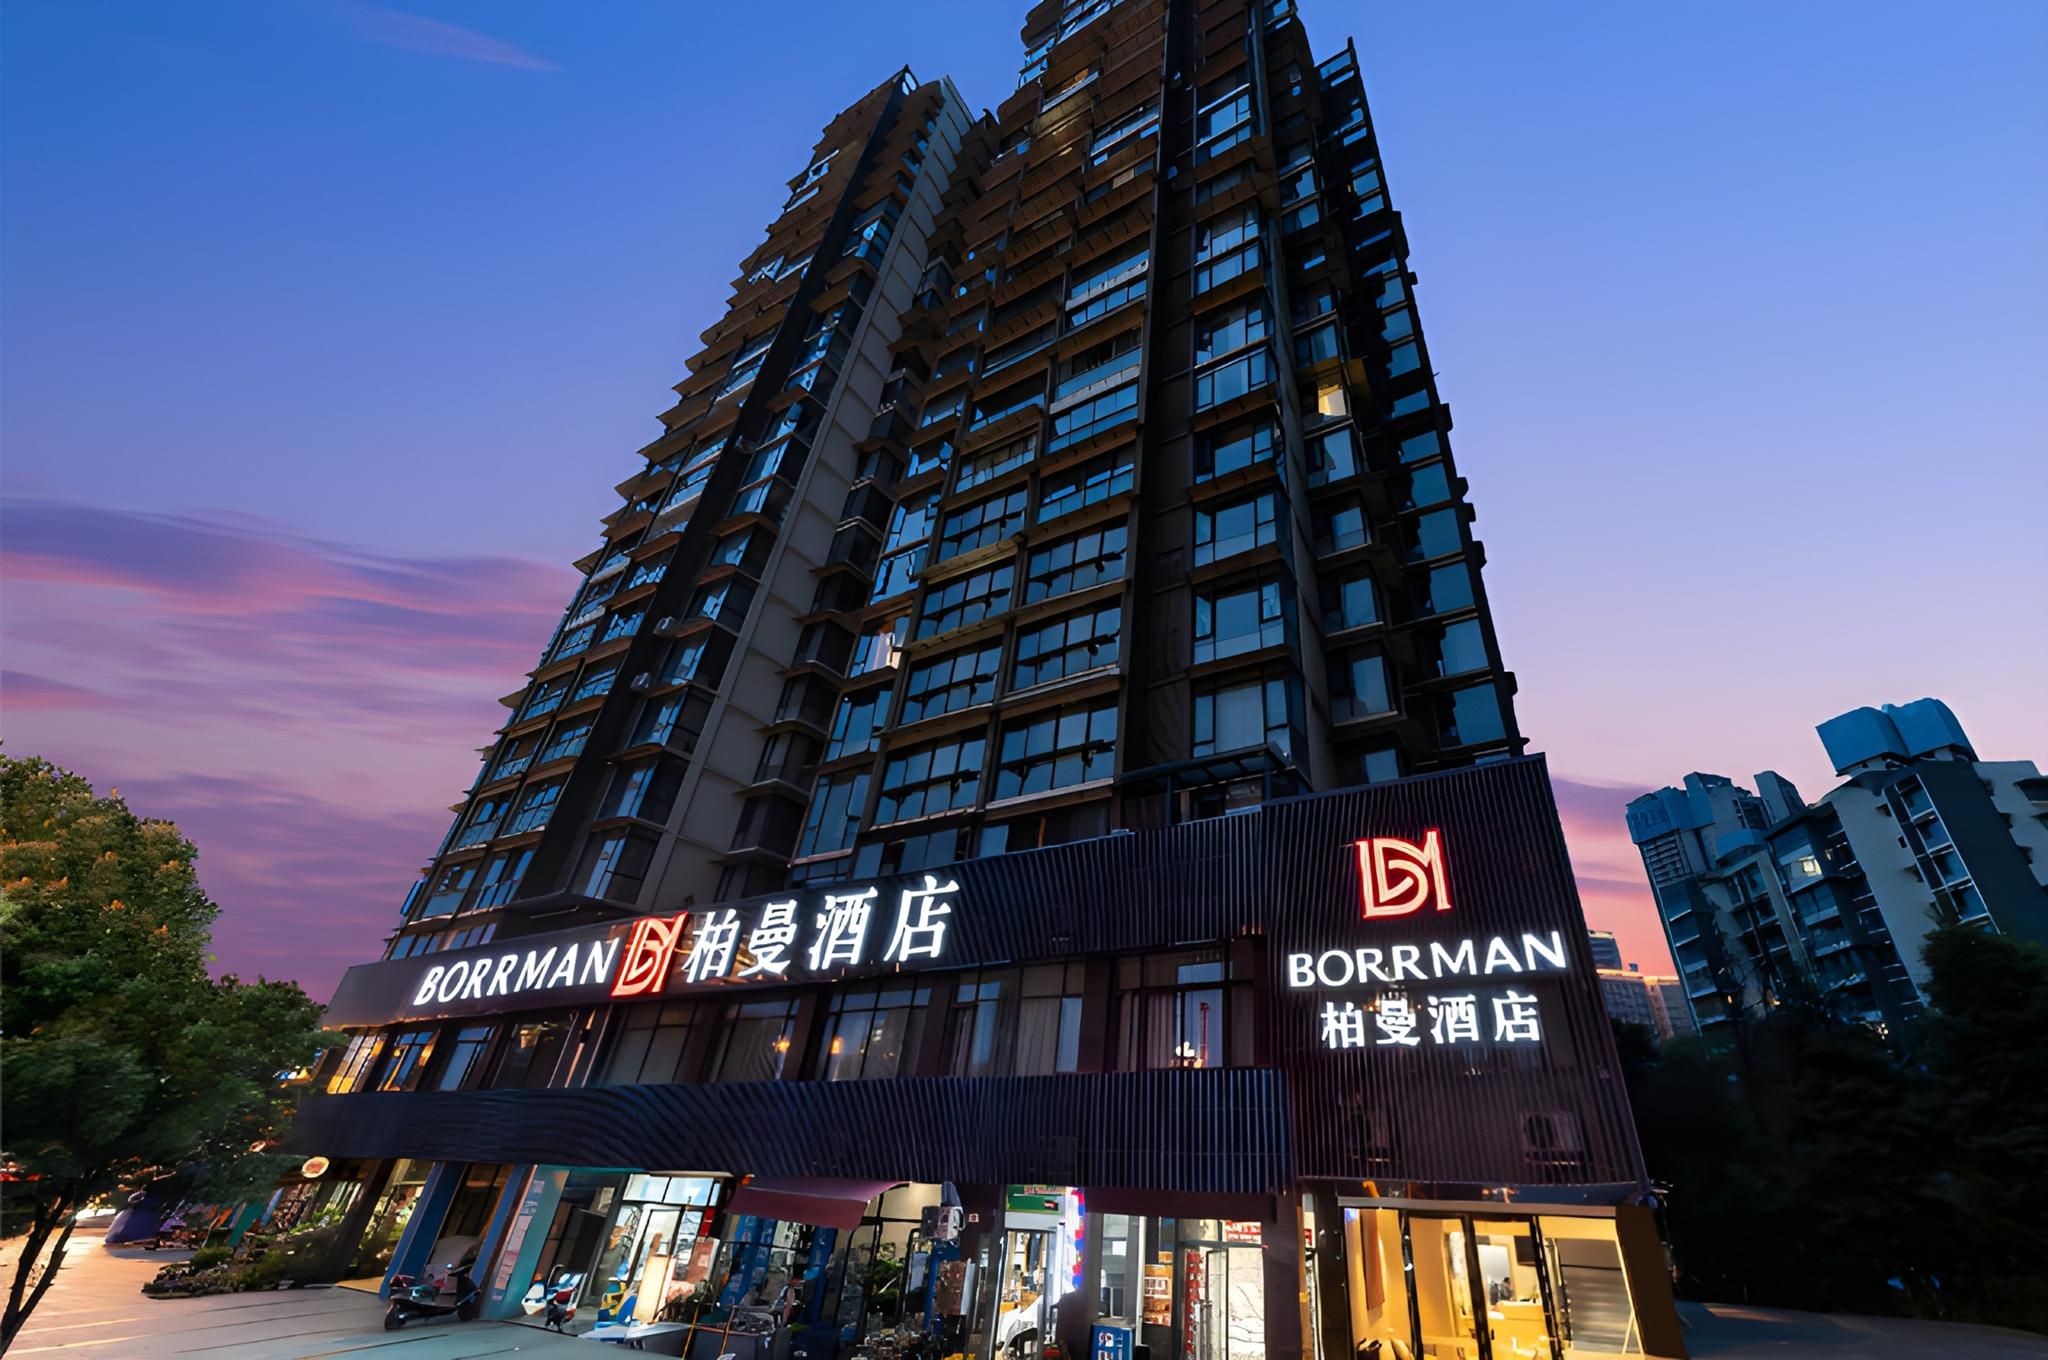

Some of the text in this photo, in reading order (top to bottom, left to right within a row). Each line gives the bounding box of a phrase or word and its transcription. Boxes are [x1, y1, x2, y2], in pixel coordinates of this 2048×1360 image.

[682, 876, 959, 983] 柏曼酒店
[1288, 931, 1567, 988] BORRMAN
[413, 938, 619, 1006] BORRMAN
[1321, 990, 1540, 1049] 柏曼酒店
